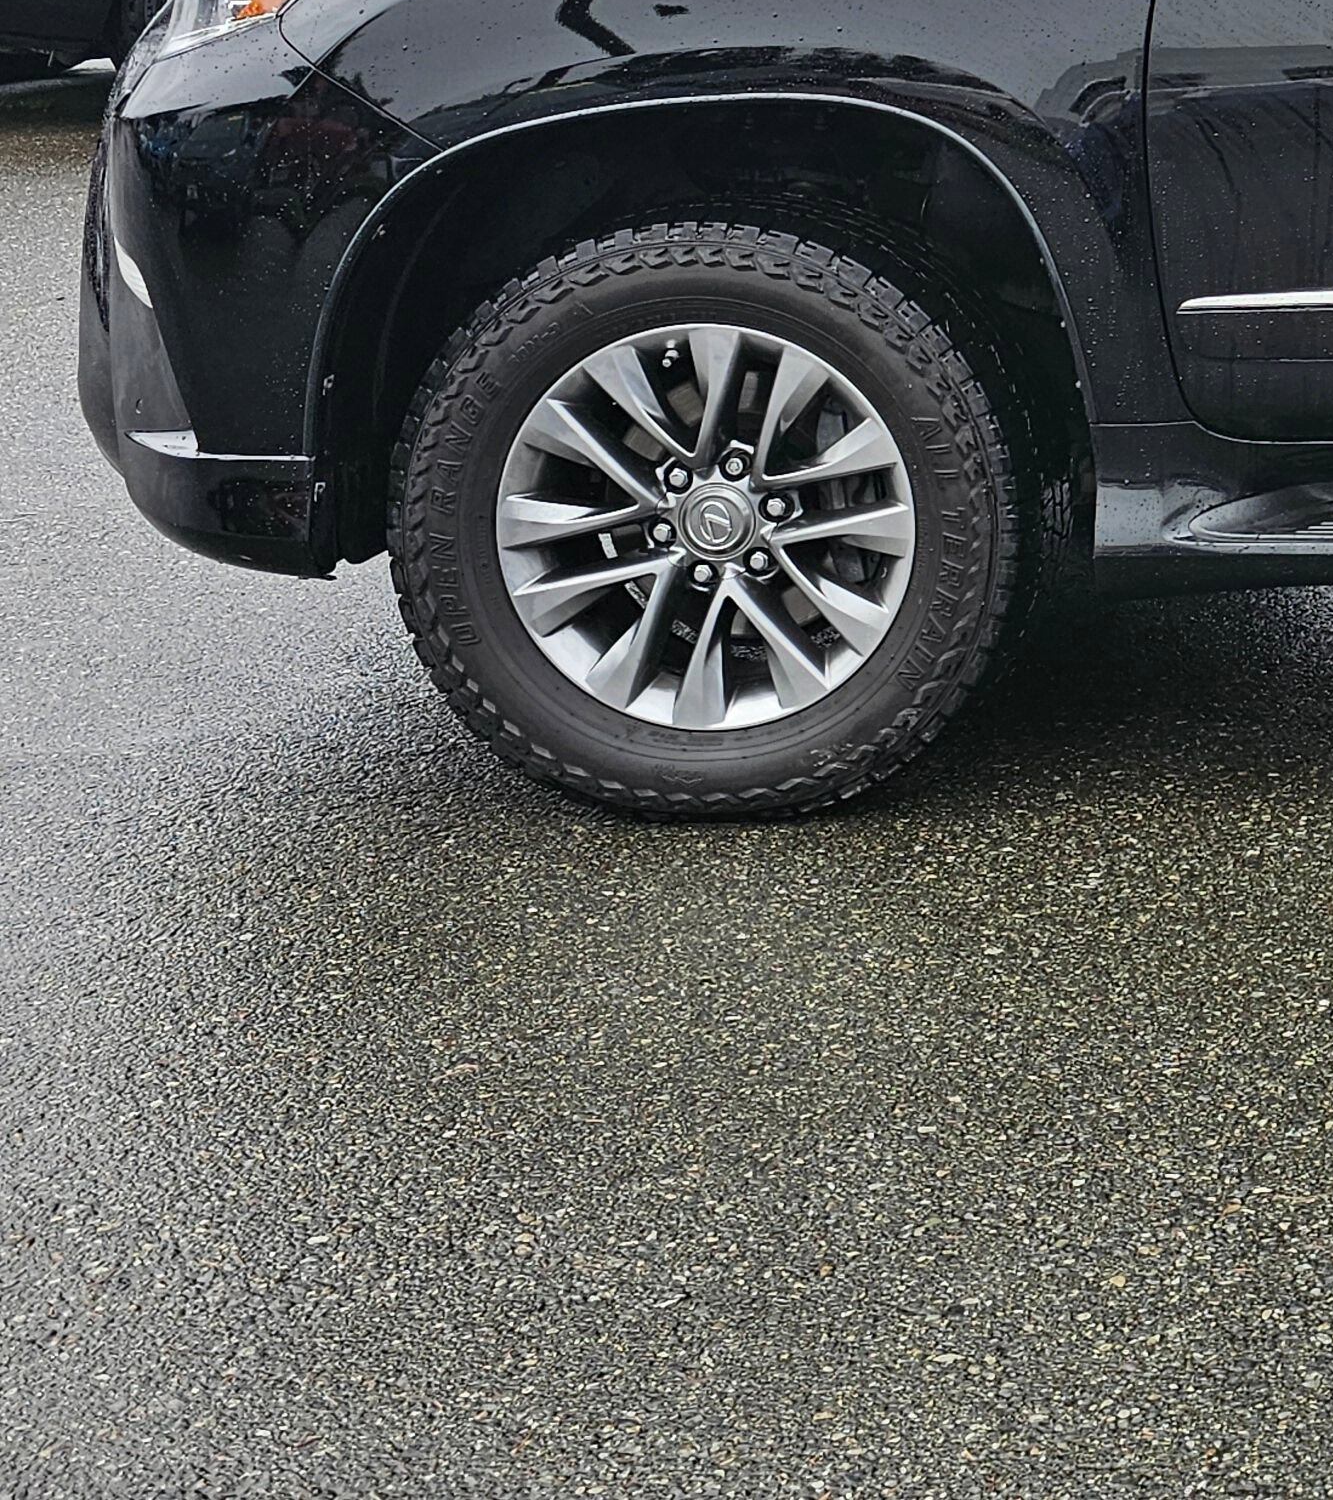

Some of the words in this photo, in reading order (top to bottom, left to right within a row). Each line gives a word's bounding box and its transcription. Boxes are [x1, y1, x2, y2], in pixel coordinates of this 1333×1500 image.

[431, 371, 499, 514] RANGE
[430, 532, 481, 646] OPEN
[897, 506, 968, 691] TERRAIN
